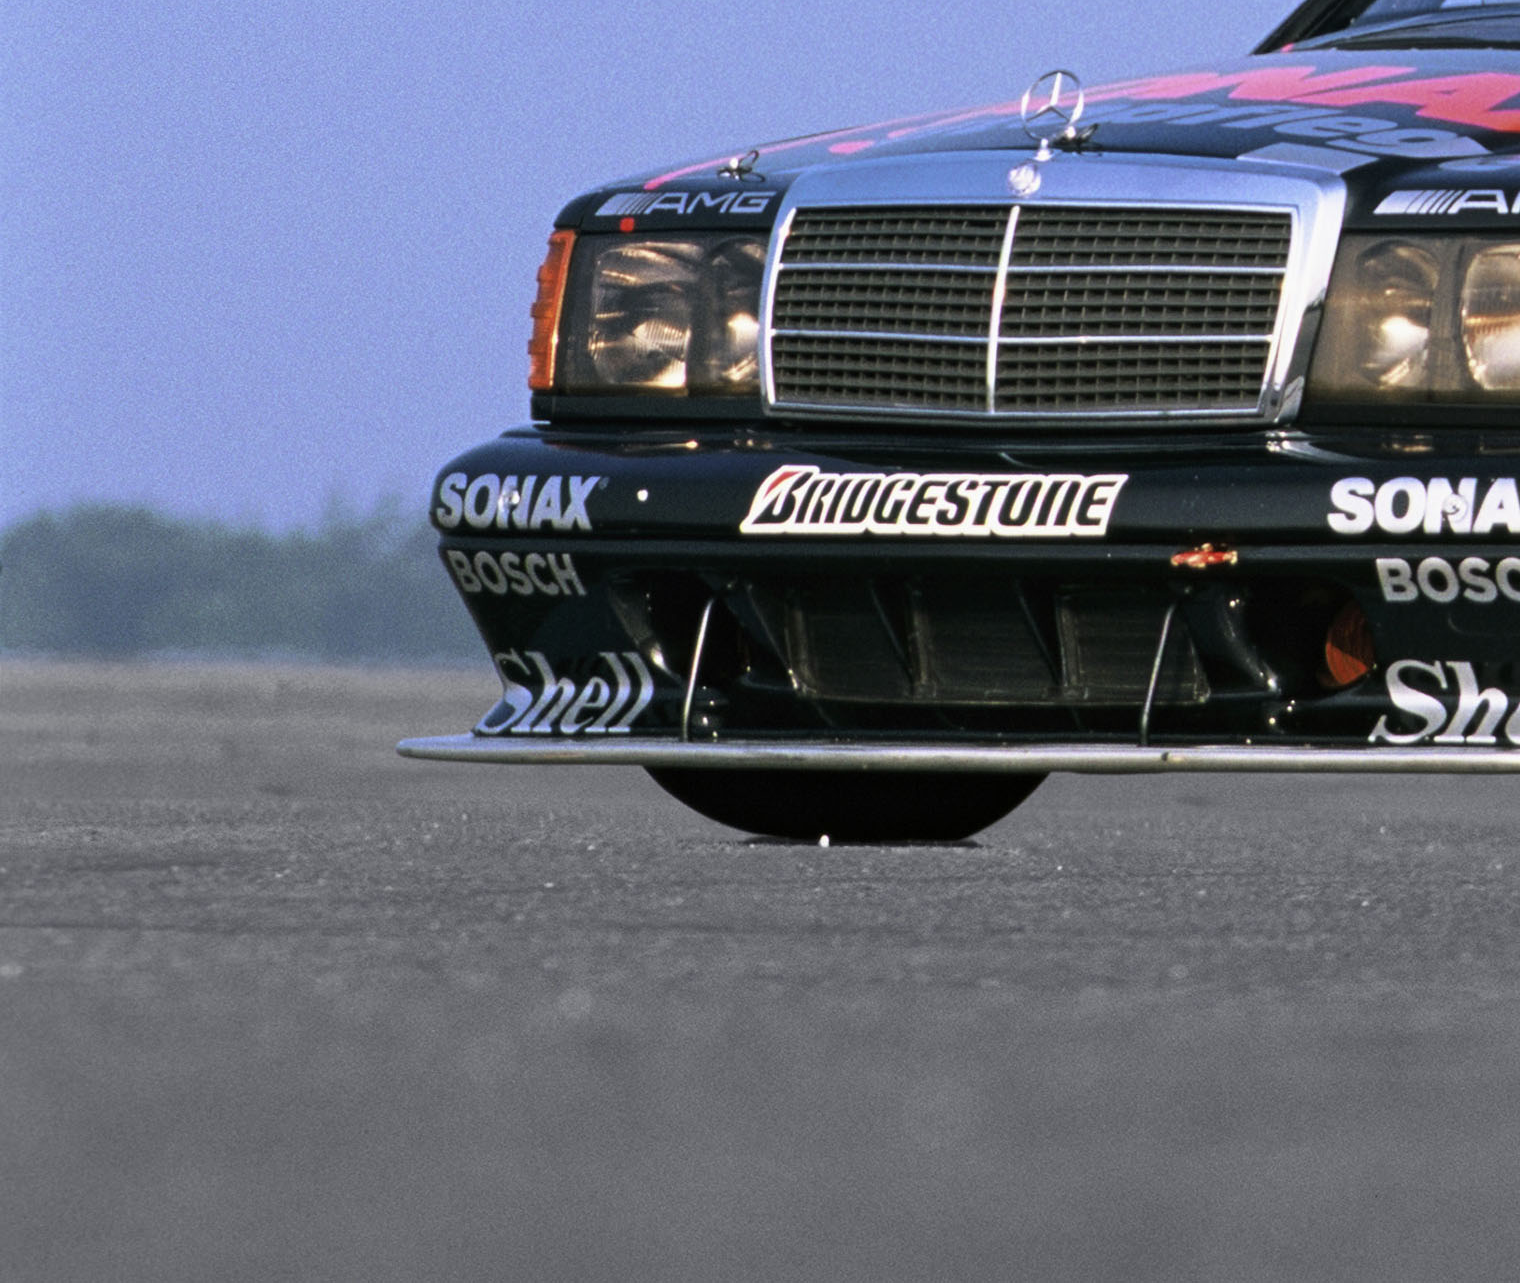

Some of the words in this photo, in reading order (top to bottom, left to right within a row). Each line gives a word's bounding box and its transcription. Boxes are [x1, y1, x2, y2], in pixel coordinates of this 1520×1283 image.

[642, 191, 777, 215] AMG
[748, 468, 1118, 529] BRIDGESTONE
[446, 549, 587, 596] BOSCH
[473, 648, 655, 734] Shell
